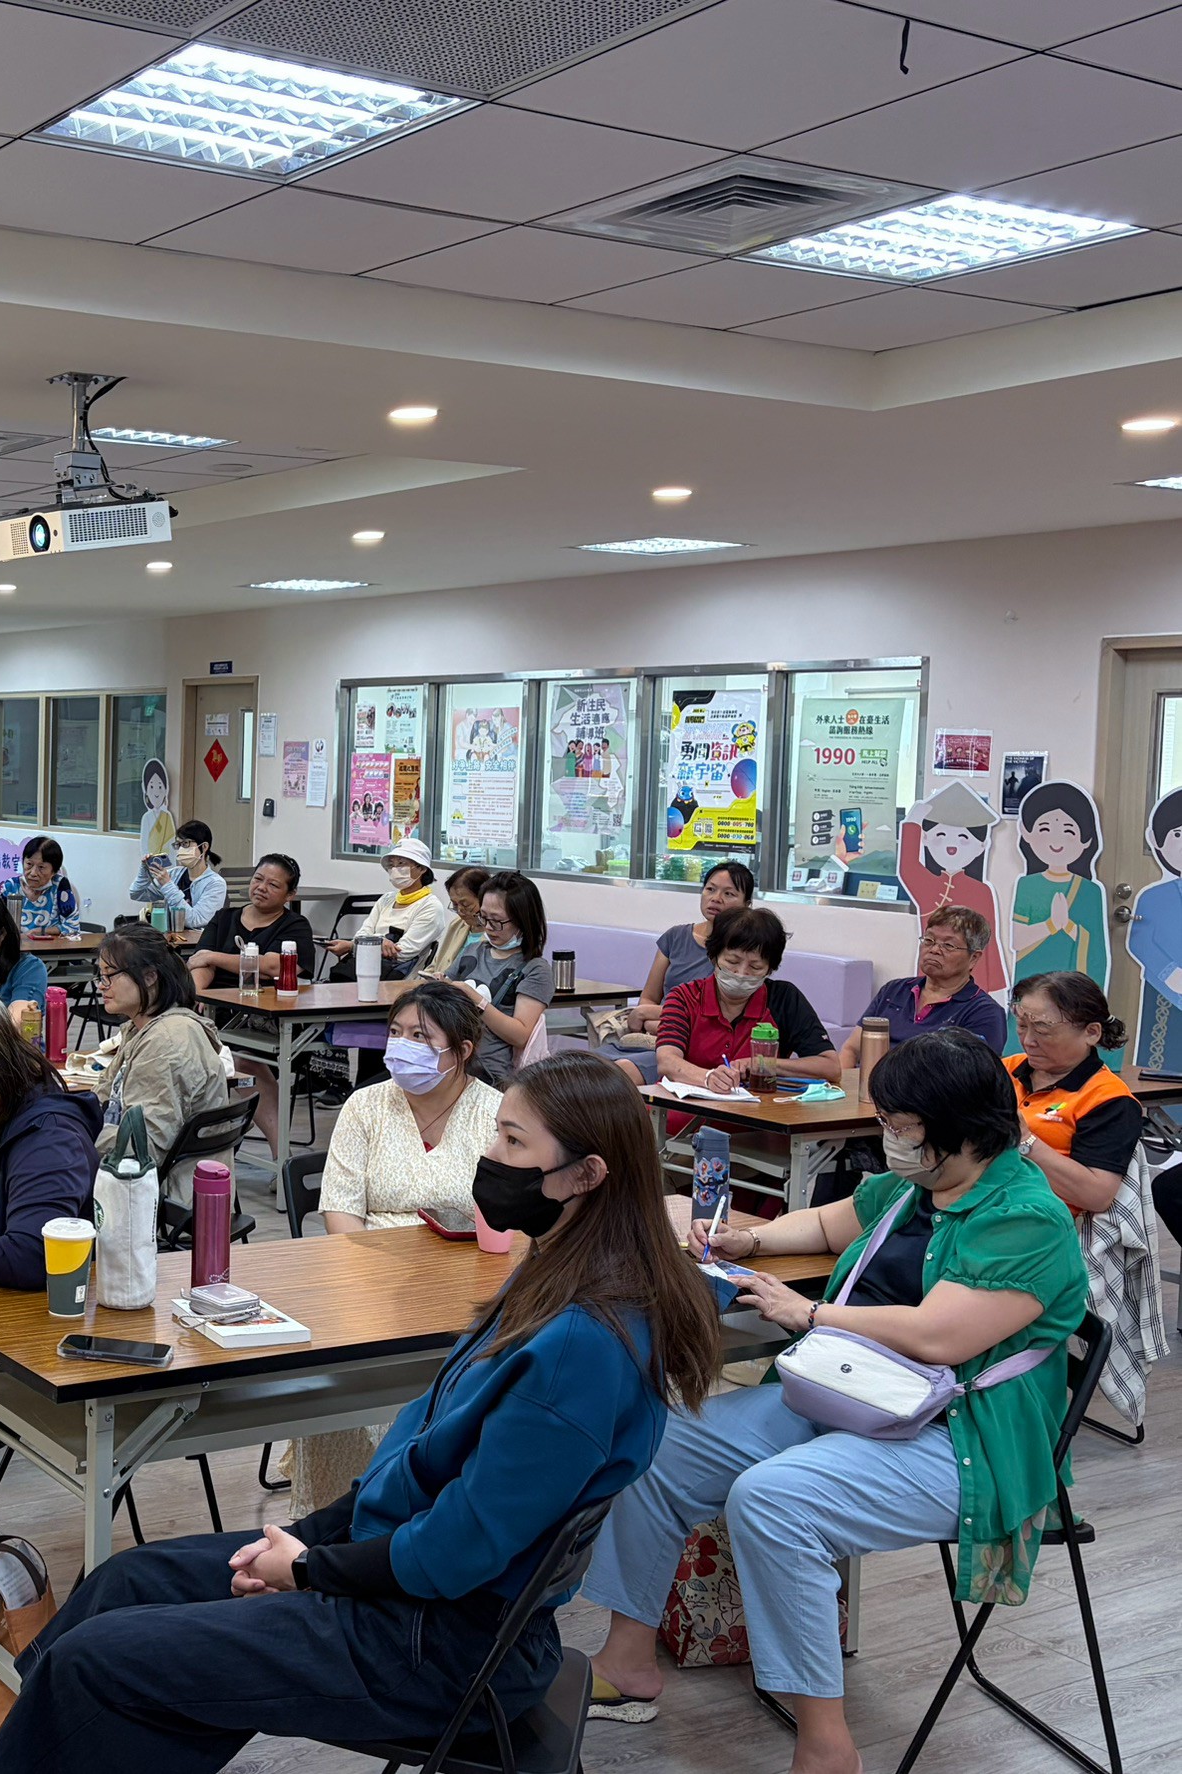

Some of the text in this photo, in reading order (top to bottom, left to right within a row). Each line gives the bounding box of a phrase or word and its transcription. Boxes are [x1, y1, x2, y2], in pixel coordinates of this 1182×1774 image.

[576, 698, 606, 712] 新住民
[570, 712, 610, 726] 生活適應
[815, 715, 890, 725] 外來人士 在臺生活
[814, 747, 856, 765] 1990
